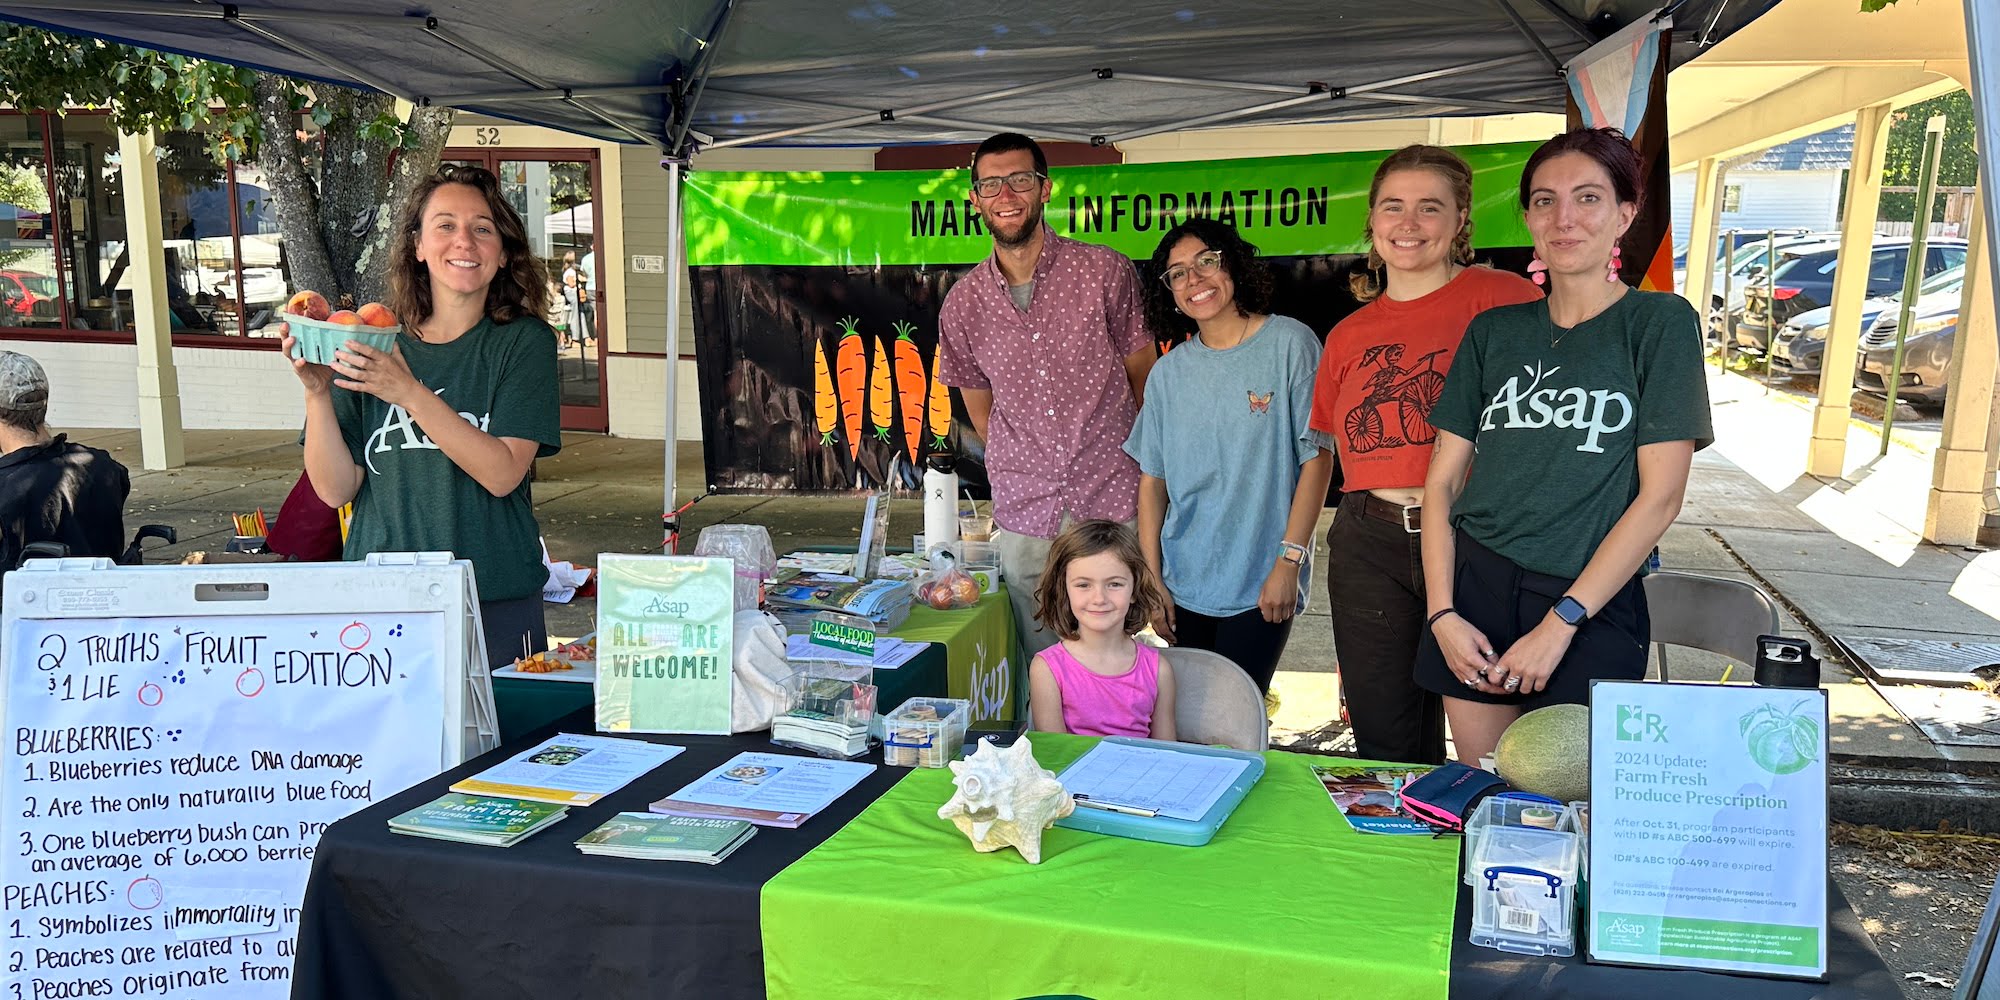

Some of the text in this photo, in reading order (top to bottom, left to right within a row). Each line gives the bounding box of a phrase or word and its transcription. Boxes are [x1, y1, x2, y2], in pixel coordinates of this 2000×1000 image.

[476, 128, 501, 146] 52
[1068, 186, 1328, 234] INFORMATION
[635, 258, 646, 270] NO
[1475, 359, 1633, 454] Asap
[643, 593, 690, 619] Asap
[613, 622, 648, 647] ALL
[682, 624, 719, 649] ARE
[814, 621, 875, 643] LOCAL FOOD
[38, 633, 67, 671] 2
[185, 631, 393, 687] FRUIT EDITION
[612, 655, 718, 680] WELCOME!
[83, 674, 120, 701] LIE
[16, 725, 161, 756] BLUEBERRIES:
[24, 750, 363, 782] 1. Blueberries reduce DNA damage
[1615, 752, 1707, 769] 2024 Update:
[1615, 768, 1708, 786] Farm Fresh
[22, 779, 372, 818] 2. Are the only naturally blue food
[1615, 787, 1788, 810] Produce Prescription
[491, 807, 532, 817] TOUR
[19, 820, 331, 856] 3. One blueberry bush can pro
[1614, 817, 1640, 828] After
[1642, 819, 1665, 829] Oct.
[1683, 823, 1728, 834] program
[1731, 826, 1796, 837] participants
[1614, 830, 1796, 850] with ID #s ABC 500-699 will expire.
[31, 859, 56, 873] an
[61, 854, 143, 872] average
[154, 847, 177, 866] of
[258, 844, 317, 861] berrie
[1642, 856, 1665, 865] ABC
[1667, 857, 1710, 868] 100-499
[1712, 861, 1729, 869] are
[1731, 862, 1776, 873] expired.
[4, 880, 115, 910] PEACHES:
[10, 919, 31, 939] 1.
[38, 913, 153, 939] Symbolizes
[1605, 917, 1645, 938] Asap
[9, 951, 28, 973] 2.
[36, 948, 115, 969] Peaches
[121, 946, 156, 966] are
[164, 937, 232, 961] related
[242, 938, 263, 955] to
[32, 978, 113, 1000] Peaches
[123, 965, 229, 995] originate
[240, 961, 290, 981] from
